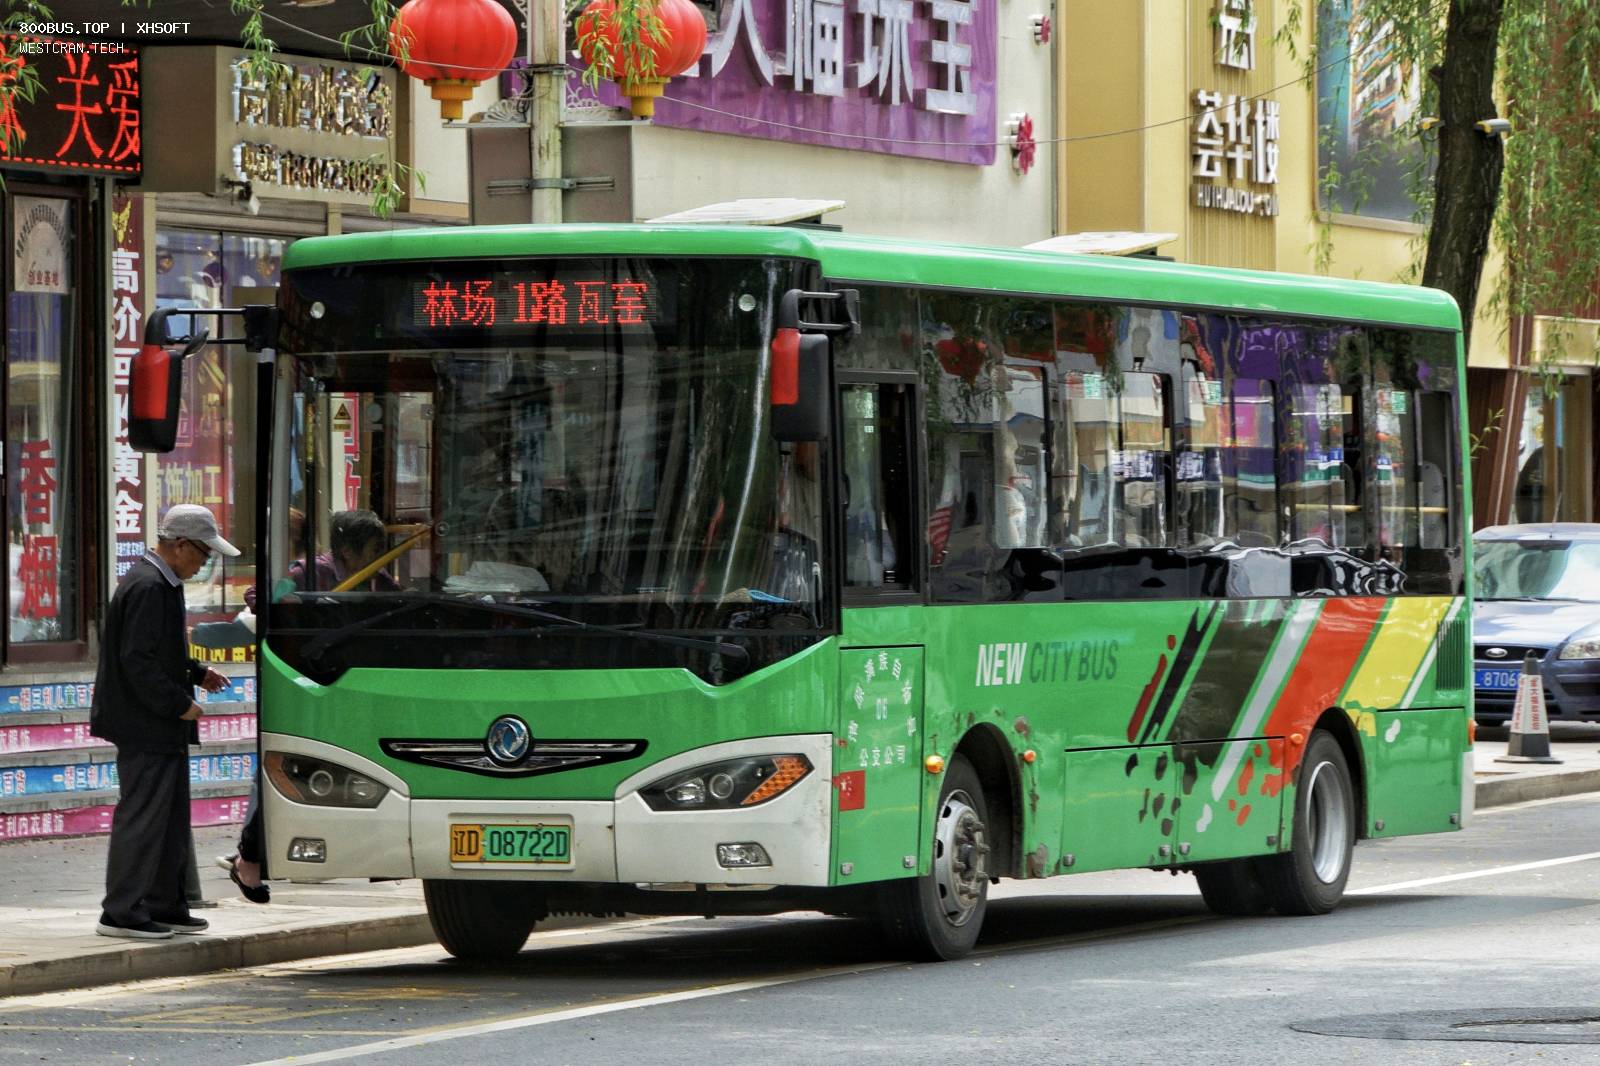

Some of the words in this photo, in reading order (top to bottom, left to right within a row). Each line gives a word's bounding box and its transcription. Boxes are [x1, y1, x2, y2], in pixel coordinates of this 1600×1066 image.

[422, 281, 496, 326] 林场
[512, 280, 567, 325] 1路
[975, 642, 1027, 686] NEW
[1029, 640, 1075, 684] CITY
[1077, 640, 1119, 682] BUS
[453, 829, 480, 857] 辽D
[489, 830, 568, 857] 08722D
